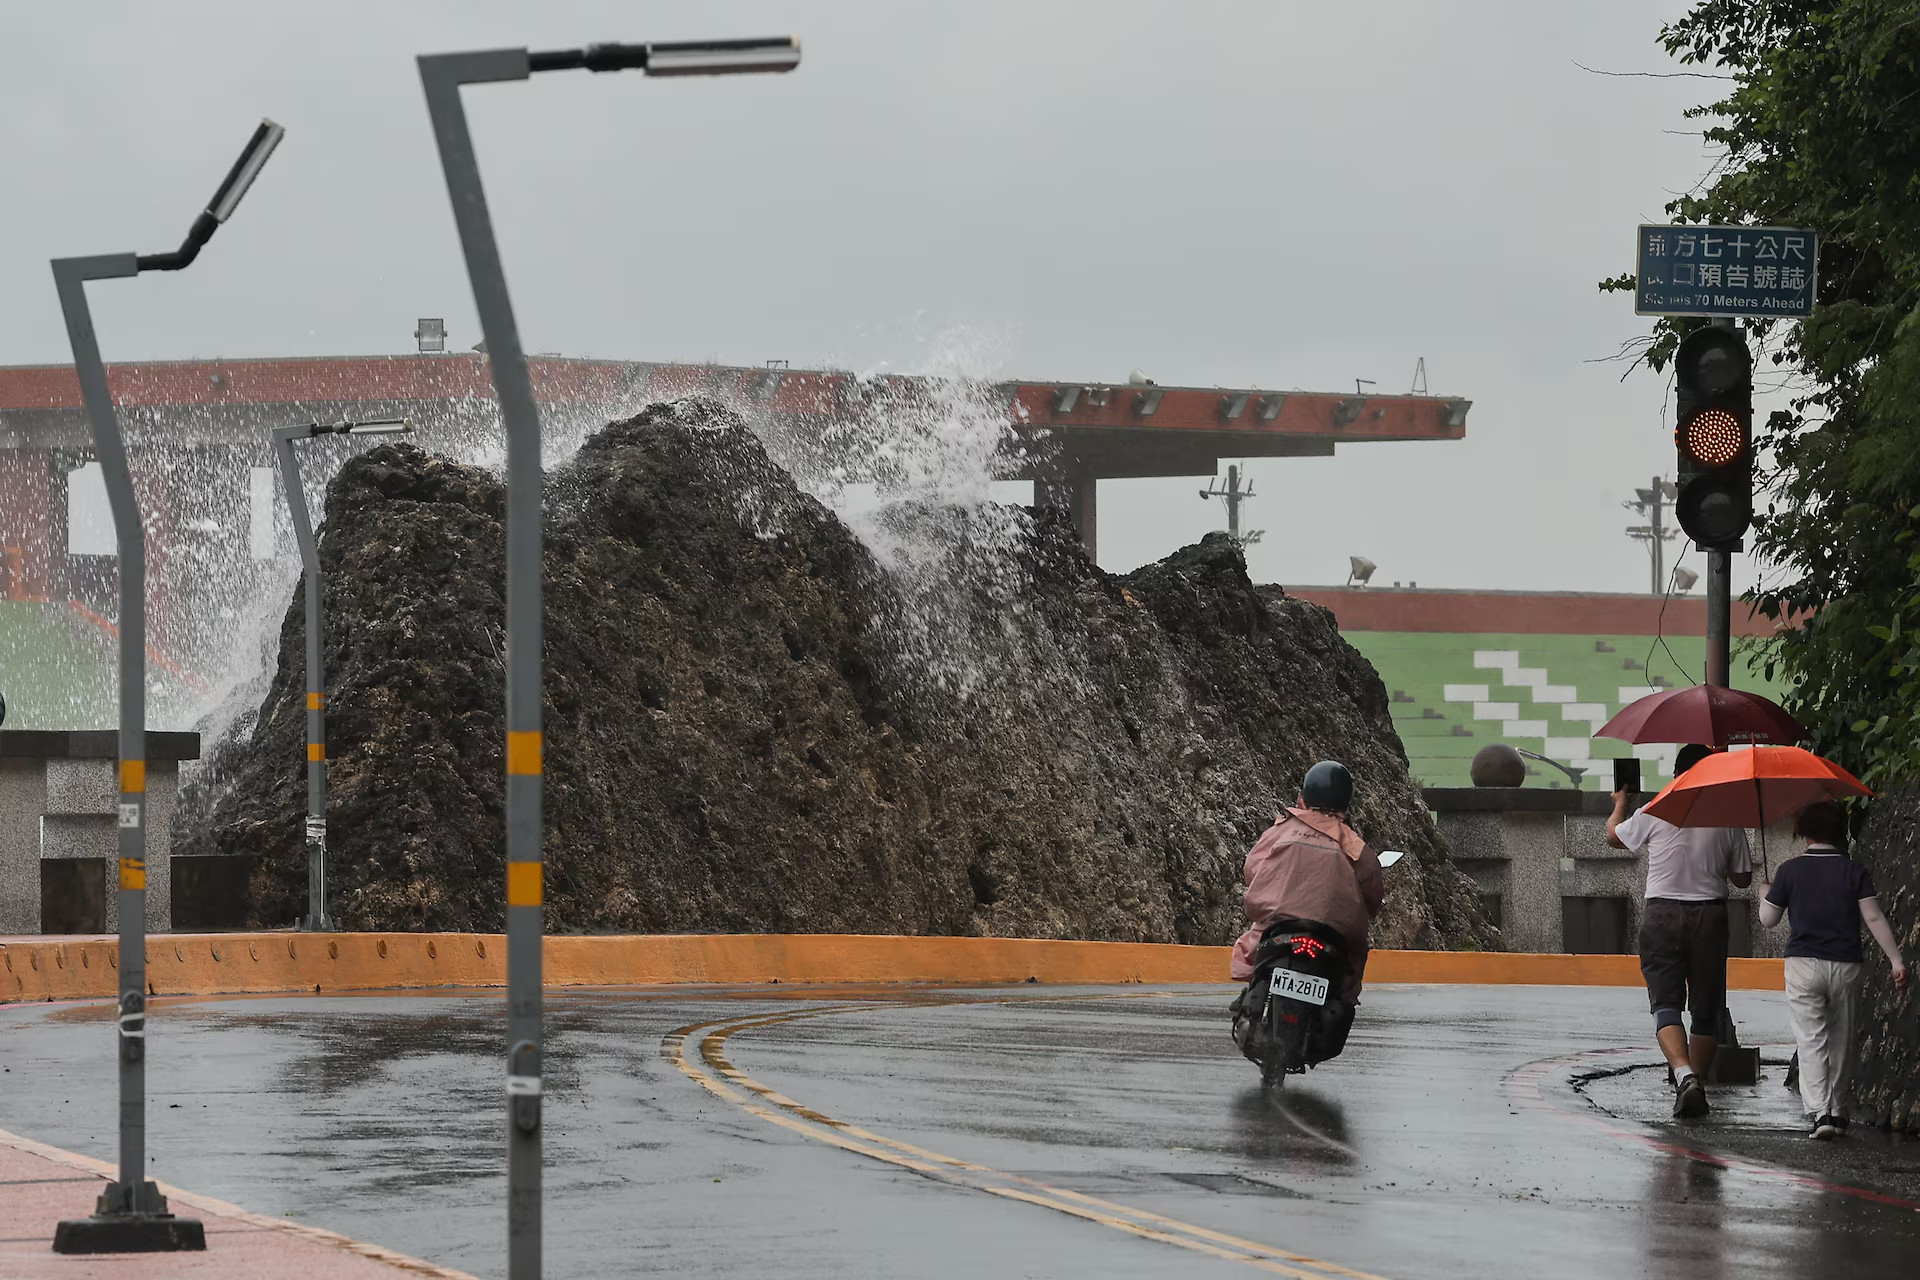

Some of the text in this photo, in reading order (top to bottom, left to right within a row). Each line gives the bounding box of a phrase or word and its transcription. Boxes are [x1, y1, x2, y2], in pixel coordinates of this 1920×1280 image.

[1647, 263, 1806, 291] 口預告號誌
[1694, 294, 1710, 306] 70
[1713, 295, 1758, 308] Meters
[1762, 296, 1805, 310] Ahead
[1273, 974, 1326, 999] MTA-2810
